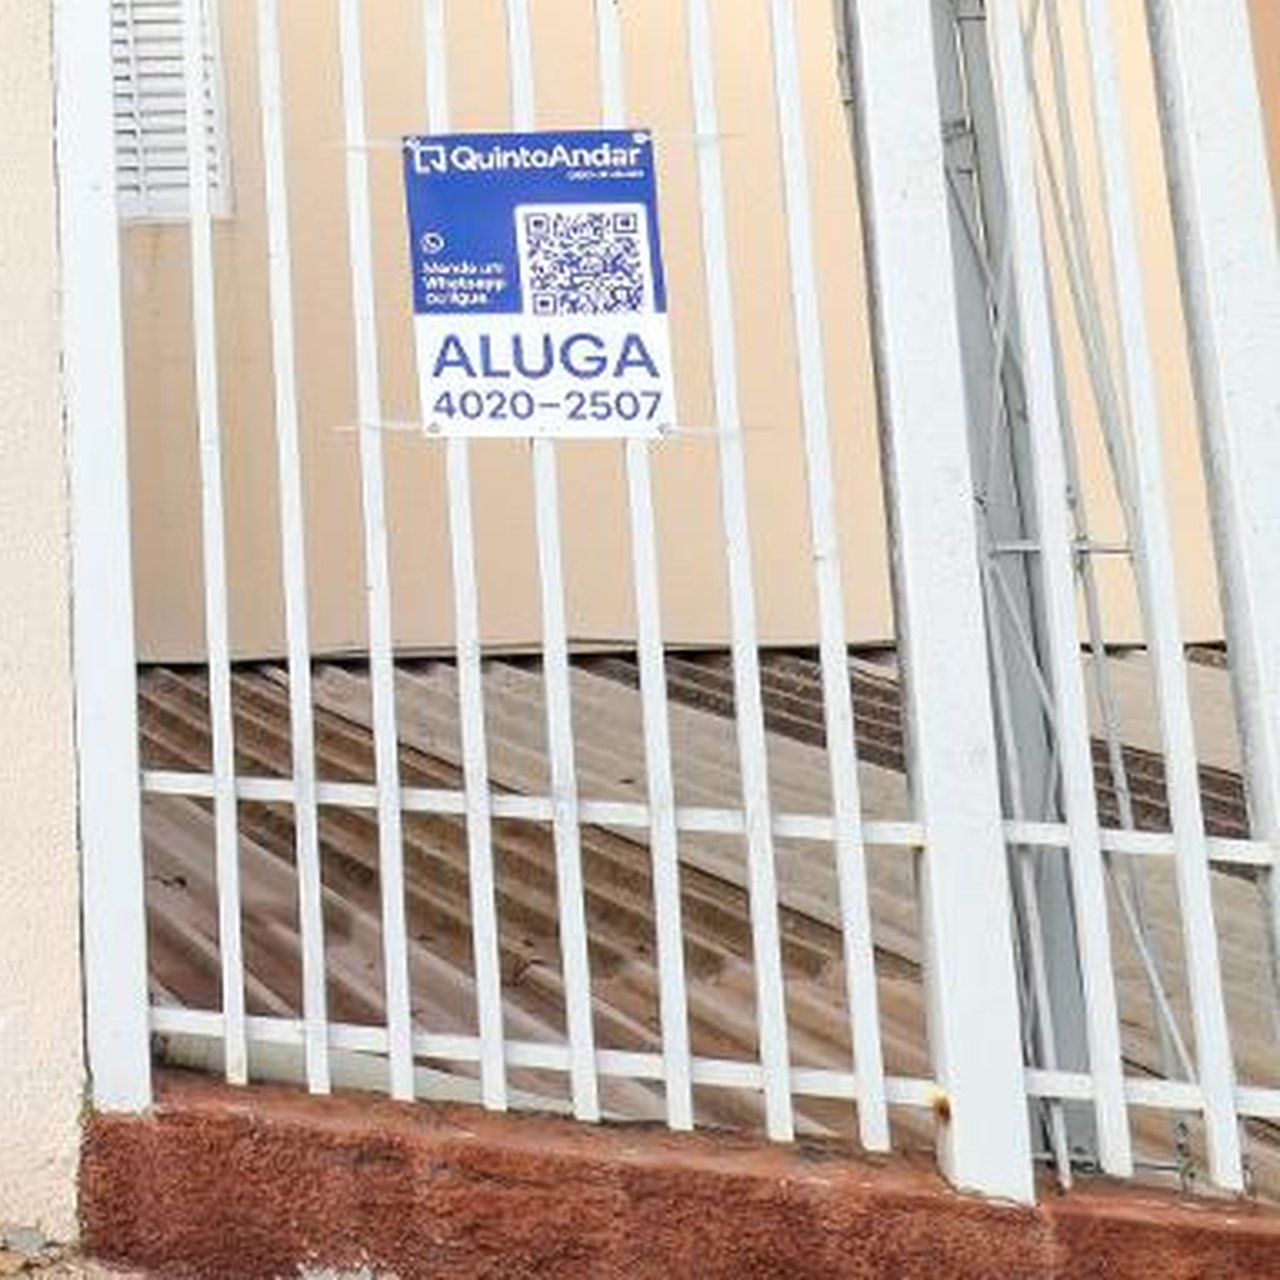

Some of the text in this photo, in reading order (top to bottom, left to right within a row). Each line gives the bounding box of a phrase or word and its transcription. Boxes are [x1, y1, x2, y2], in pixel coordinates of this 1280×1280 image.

[450, 143, 642, 170] QuintoAndar
[432, 333, 661, 379] ALUGA
[432, 390, 662, 420] 4020-2507
